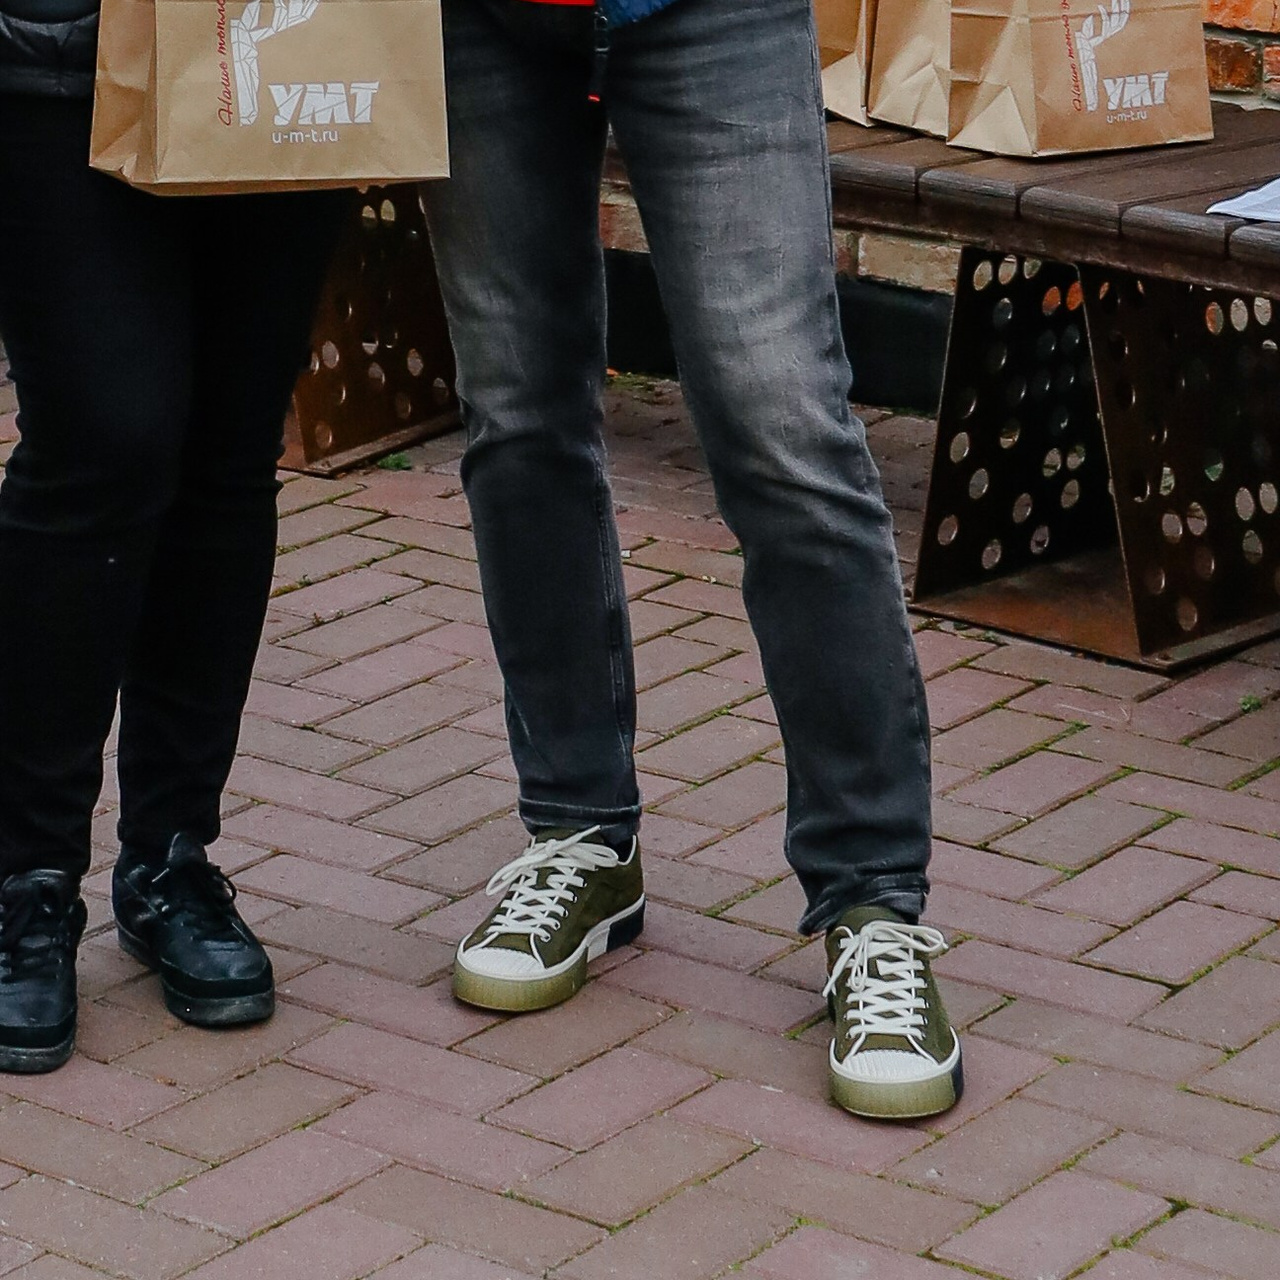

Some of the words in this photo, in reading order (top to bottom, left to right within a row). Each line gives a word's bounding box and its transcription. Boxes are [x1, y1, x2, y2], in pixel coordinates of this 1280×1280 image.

[218, 61, 231, 126] Наше
[268, 81, 379, 126] УМТ
[1103, 71, 1169, 111] УМТ
[272, 129, 339, 144] u-m-t.ru
[1106, 109, 1148, 124] u-m-t.ru
